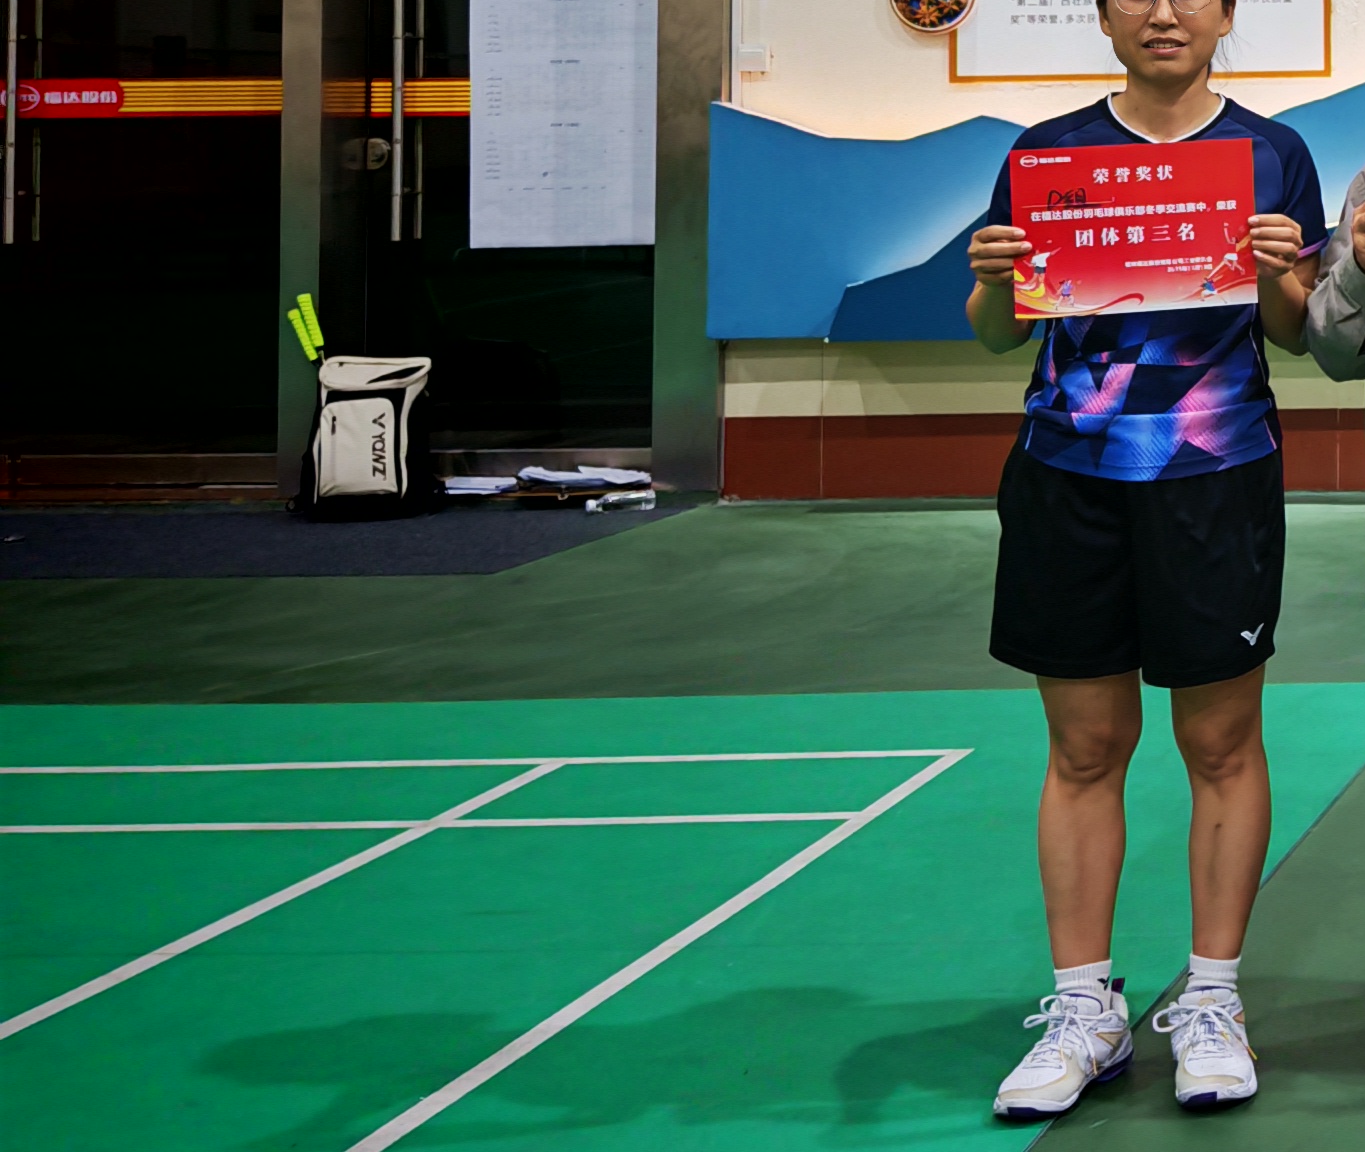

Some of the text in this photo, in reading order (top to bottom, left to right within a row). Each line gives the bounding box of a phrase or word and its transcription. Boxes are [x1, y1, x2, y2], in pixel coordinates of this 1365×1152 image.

[1092, 165, 1174, 183] 荣誉奖状
[1075, 223, 1195, 247] 团体第三名
